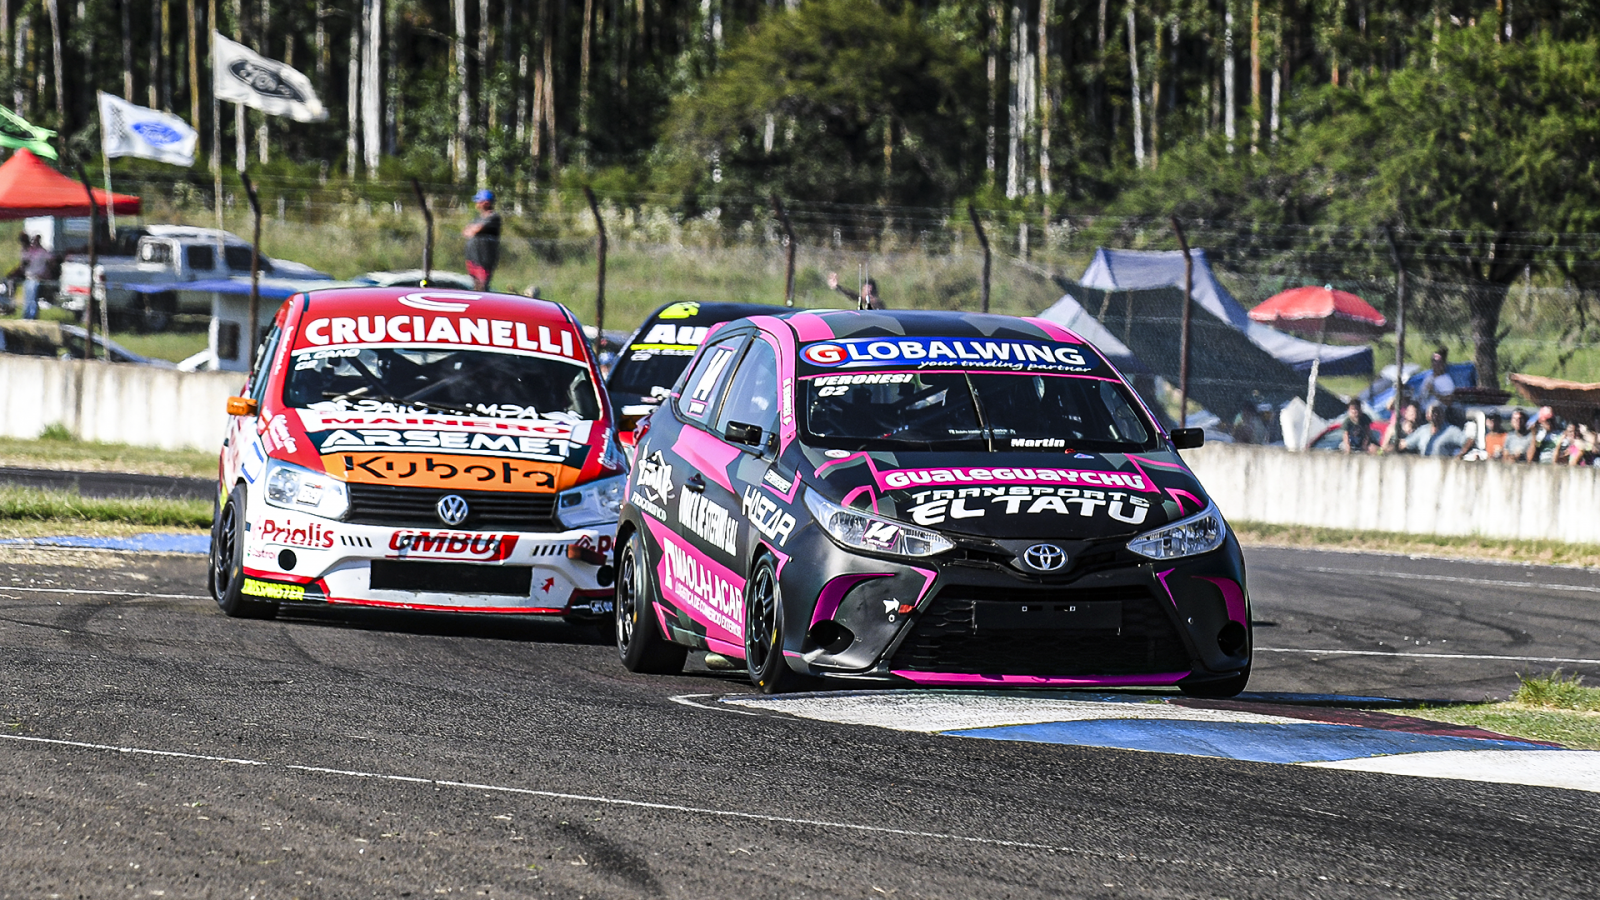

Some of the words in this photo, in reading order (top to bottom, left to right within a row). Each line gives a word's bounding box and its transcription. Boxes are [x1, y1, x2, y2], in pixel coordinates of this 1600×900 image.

[305, 315, 573, 357] CRUCIANELLI
[809, 341, 1087, 365] GLOBALWING
[918, 360, 958, 370] your
[961, 360, 1024, 370] trading
[1027, 361, 1092, 373] partner
[814, 373, 914, 387] VERONESI
[321, 418, 571, 434] MAINERO
[320, 429, 583, 458] ARSEMET
[1010, 438, 1066, 448] Martin
[344, 455, 555, 489] Kubota
[907, 500, 986, 526] EL
[864, 521, 900, 542] 14
